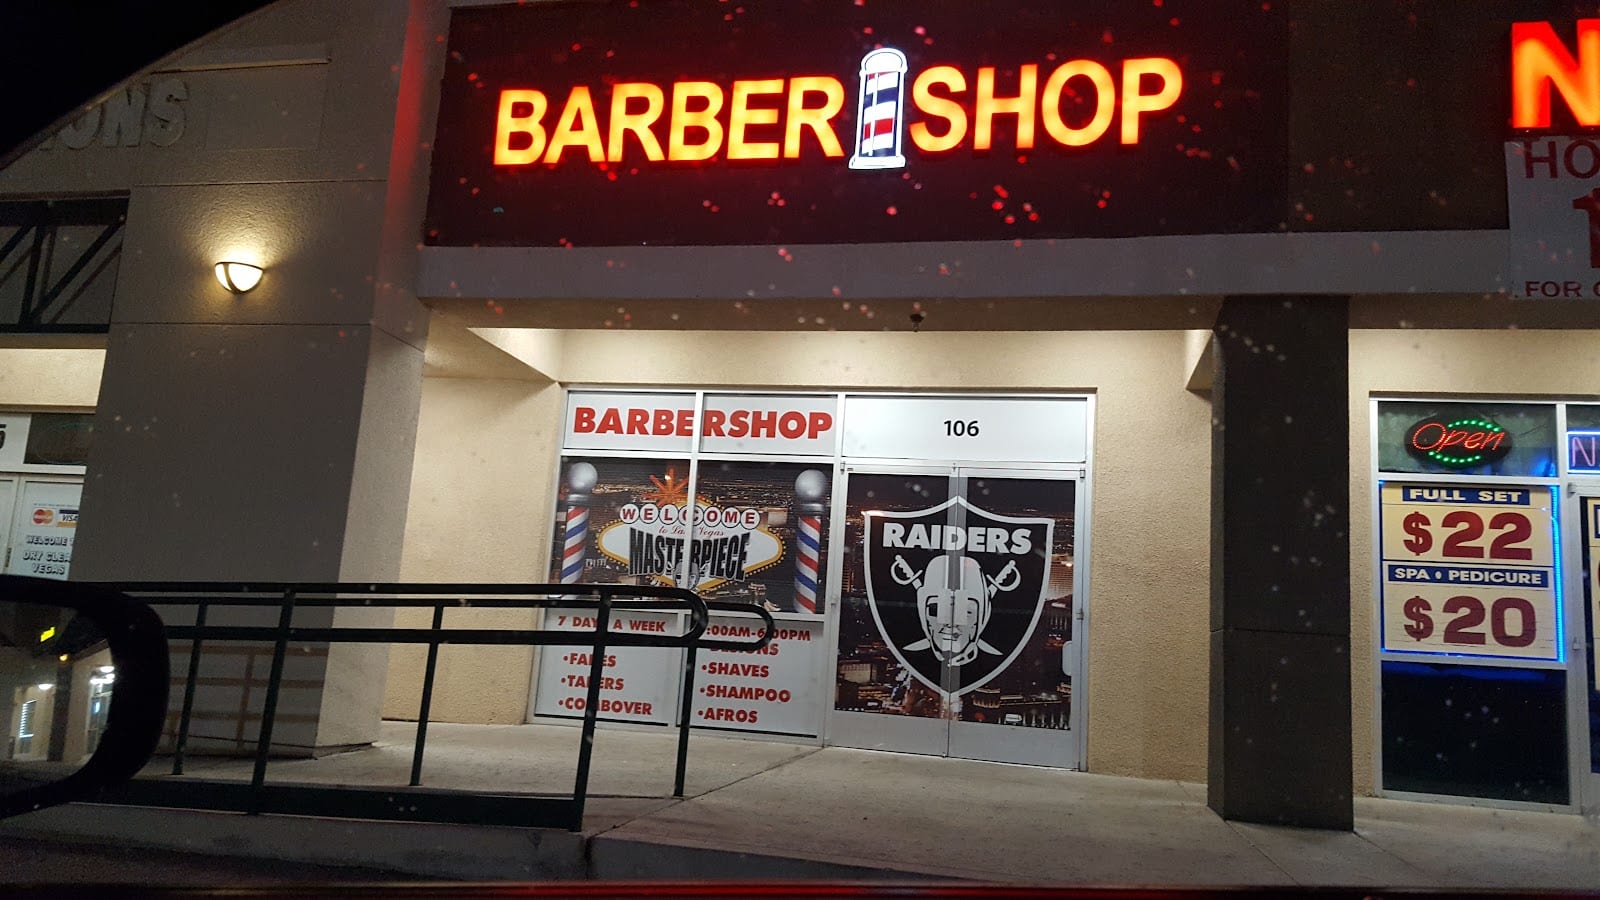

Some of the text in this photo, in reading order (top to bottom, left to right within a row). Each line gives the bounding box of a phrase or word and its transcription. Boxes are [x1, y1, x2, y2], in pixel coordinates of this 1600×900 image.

[38, 78, 189, 150] ONS
[494, 57, 1183, 165] BARBER SHOP
[1525, 281, 1582, 297] FOR
[573, 407, 832, 439] BARBERSHOP
[943, 420, 980, 437] 106
[1412, 423, 1505, 453] Open
[1409, 488, 1522, 502] FULL SET
[622, 507, 755, 525] WELCOME
[26, 534, 67, 546] WELCOME
[882, 522, 1032, 555] RAIDERS
[1402, 511, 1533, 561] $22
[23, 551, 43, 561] DRY
[628, 527, 751, 582] MASTERPIECE
[32, 563, 65, 575] VEGAS
[1395, 568, 1542, 584] SPA PEDICURE
[558, 615, 567, 626] 7
[572, 616, 598, 628] DAY
[613, 619, 623, 630] A
[629, 620, 666, 632] WEEK
[1403, 596, 1536, 648] $20
[708, 662, 769, 678] SHAVES
[567, 675, 624, 690] TAERS
[706, 685, 791, 703] SHAMPOO
[565, 697, 652, 715] COBOVER
[704, 708, 758, 724] AFROS
